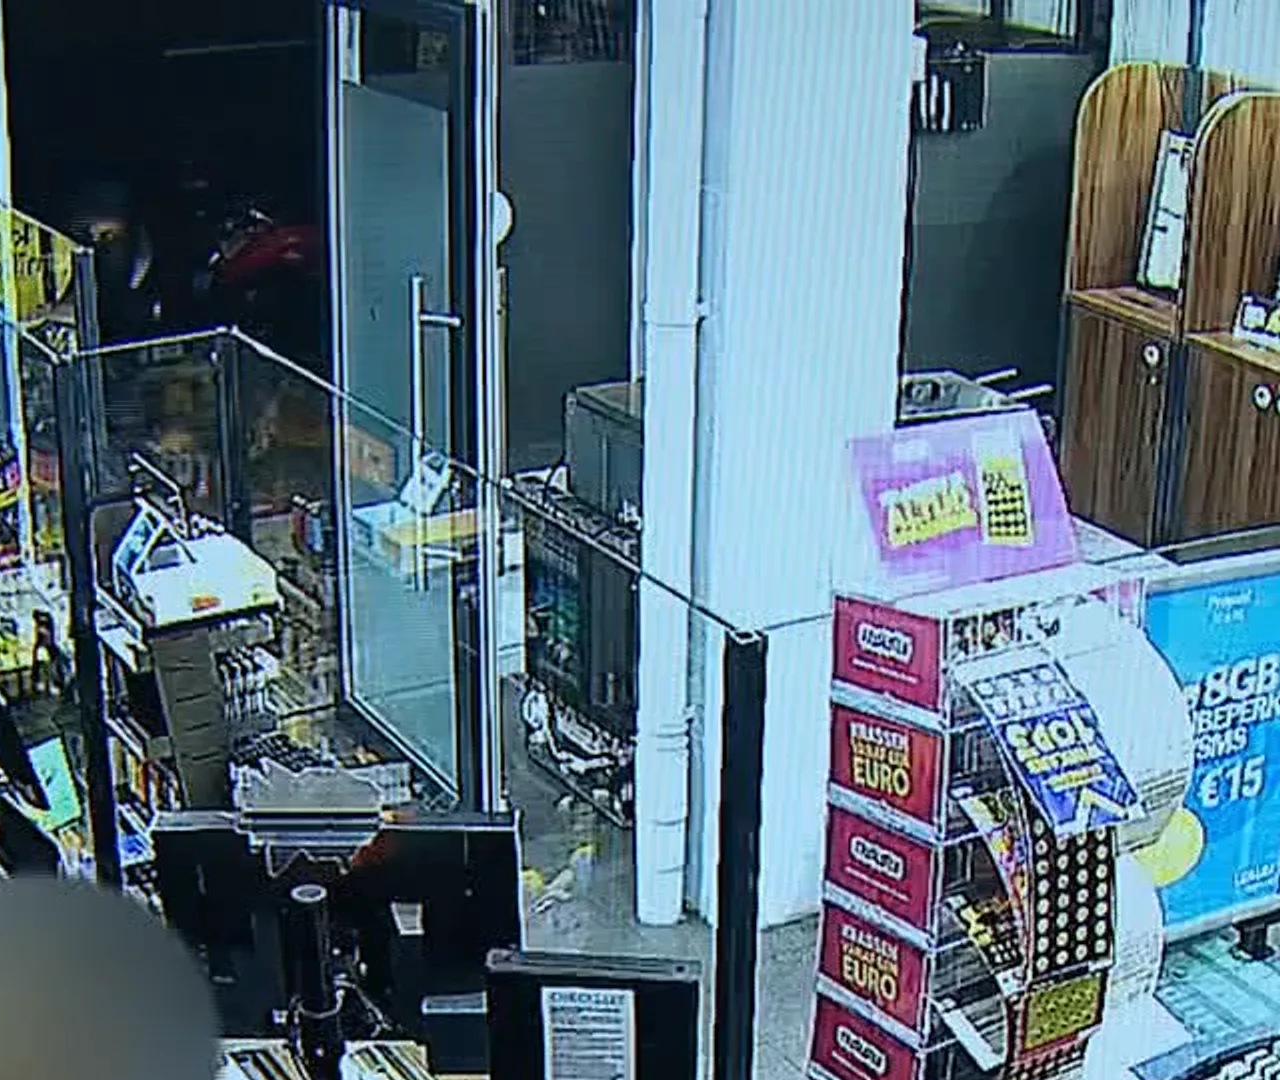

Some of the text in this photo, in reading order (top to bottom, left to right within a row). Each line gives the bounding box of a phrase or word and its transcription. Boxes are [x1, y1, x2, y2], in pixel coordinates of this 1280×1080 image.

[853, 755, 910, 797] EURO
[549, 990, 626, 1005] CHECKLIST
[842, 954, 897, 1001] EURO
